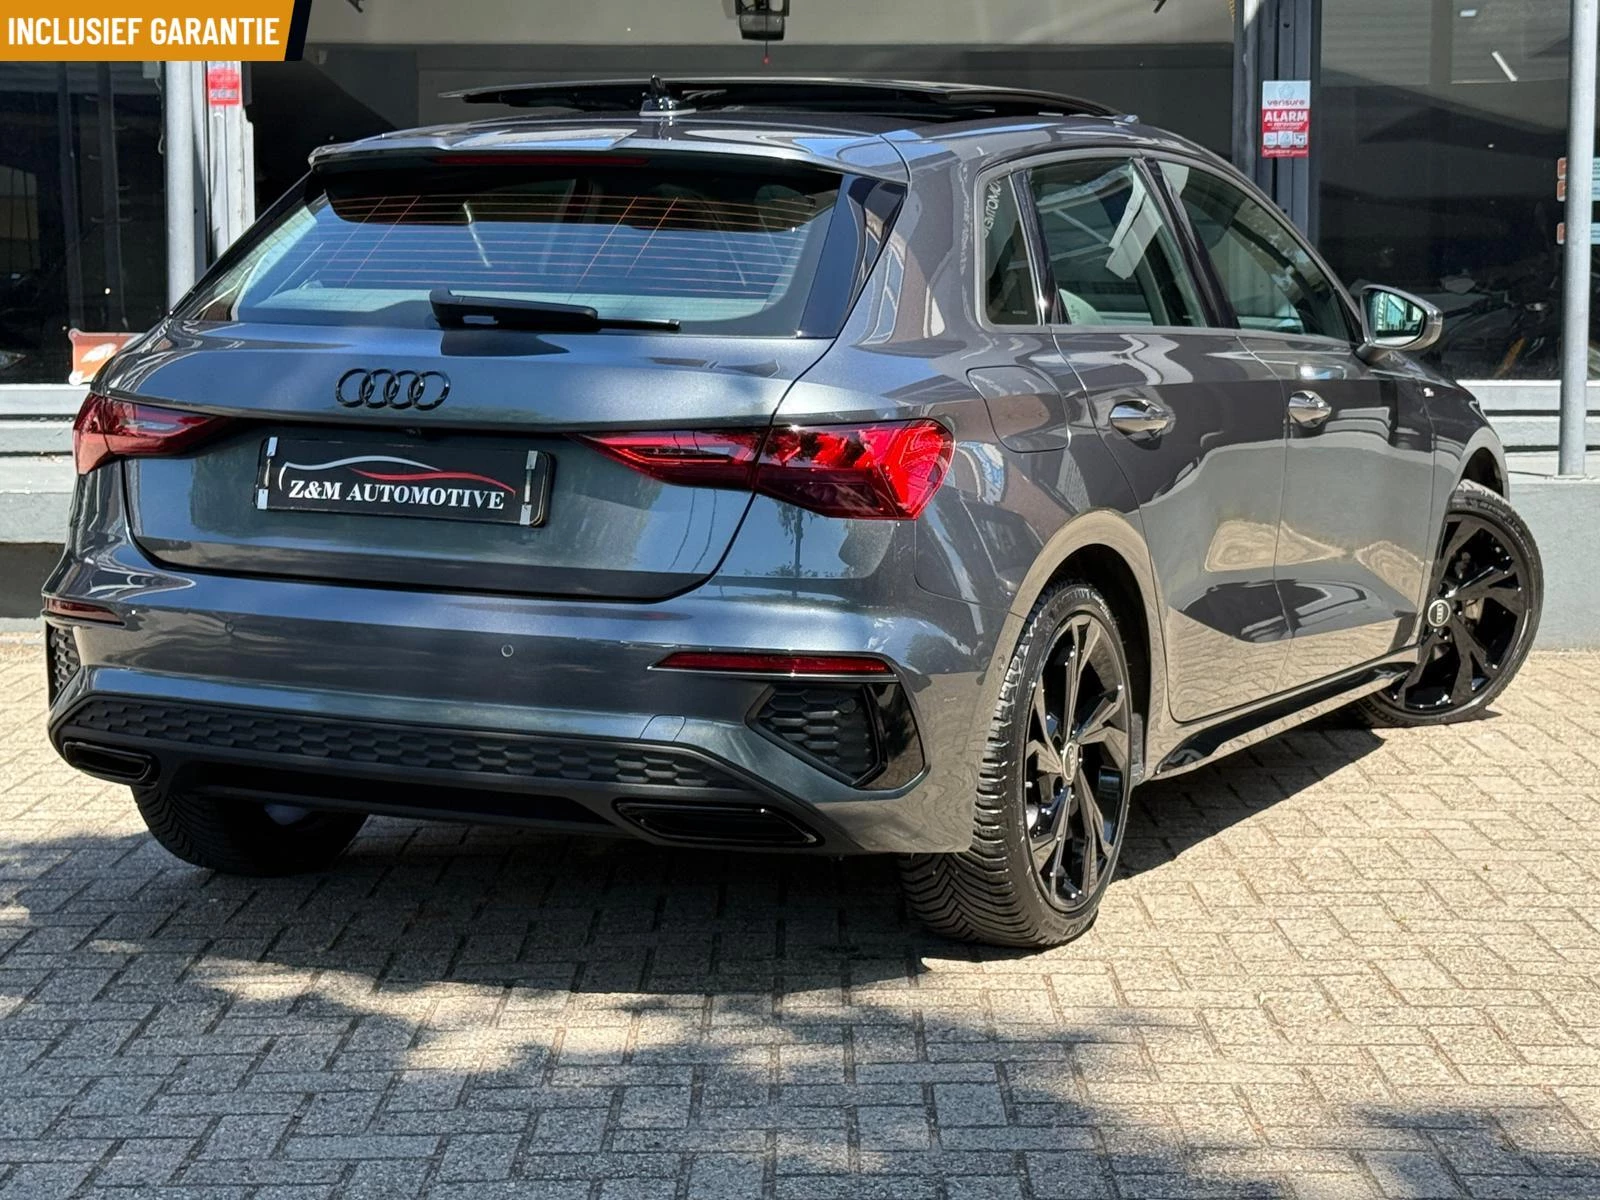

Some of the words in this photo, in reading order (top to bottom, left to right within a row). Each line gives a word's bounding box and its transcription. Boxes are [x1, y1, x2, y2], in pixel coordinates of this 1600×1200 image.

[1264, 110, 1308, 122] ALARM
[289, 480, 343, 500] Z&M
[346, 483, 505, 510] AUTOMOTIVE
